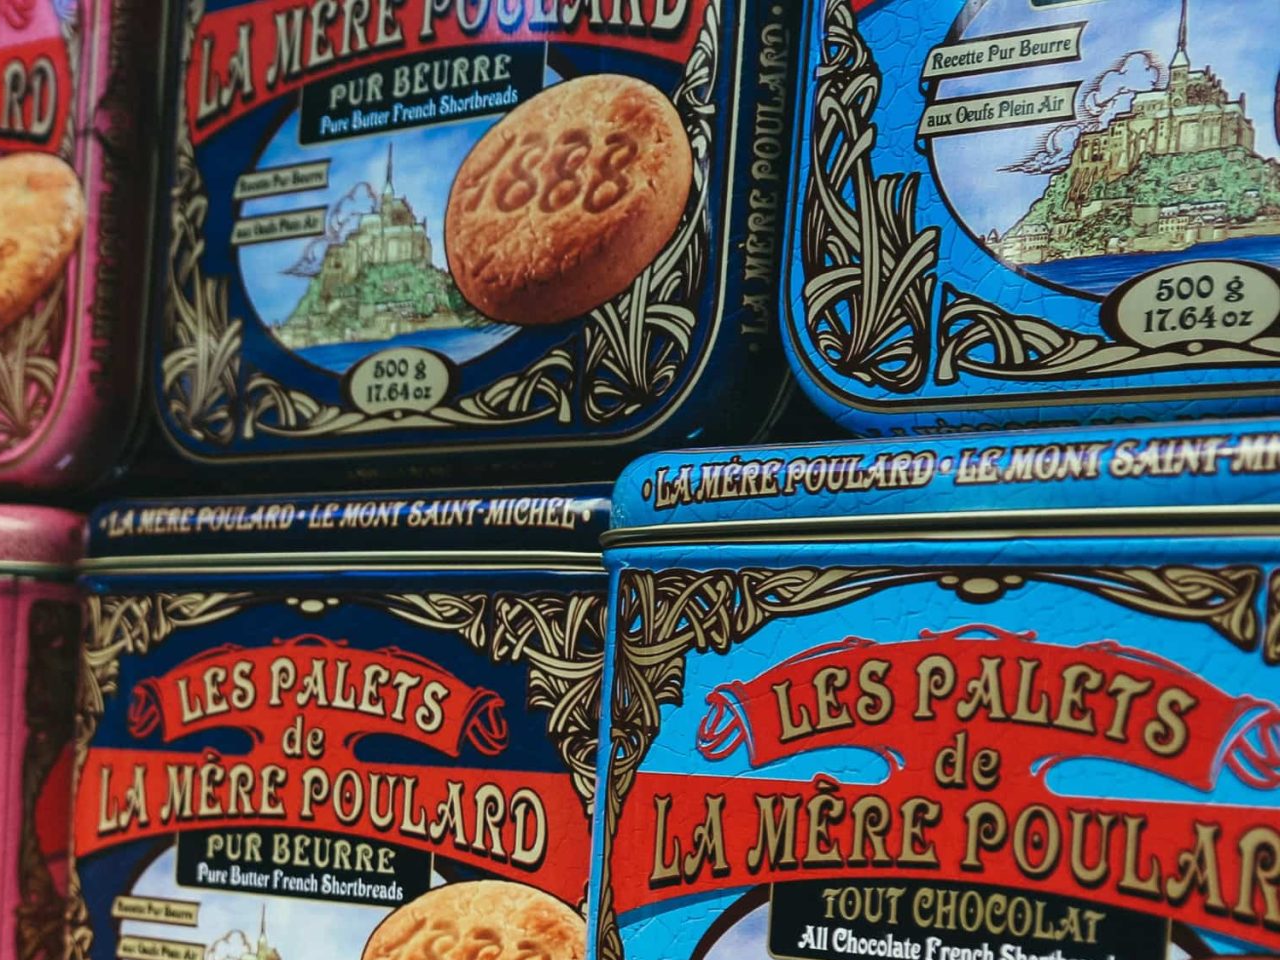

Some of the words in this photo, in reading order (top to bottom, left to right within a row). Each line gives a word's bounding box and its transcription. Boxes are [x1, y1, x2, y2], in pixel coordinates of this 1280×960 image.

[197, 22, 254, 124] LA
[931, 50, 984, 71] Recette
[988, 44, 1016, 62] Pur
[1019, 38, 1072, 58] Beurre
[329, 73, 384, 110] PUR
[392, 54, 512, 98] BEURRE
[751, 23, 789, 181] POULARD
[320, 115, 349, 135] Pure
[351, 108, 389, 129] Butter
[393, 100, 437, 122] French
[439, 85, 519, 116] Shortbreads
[927, 113, 953, 128] aux
[956, 103, 995, 124] Oeufs
[998, 100, 1035, 119] Plein
[1037, 95, 1065, 114] Air
[462, 127, 639, 214] 1888
[738, 188, 777, 282] MÈRE
[1155, 275, 1215, 302] 500
[1224, 275, 1245, 303] g
[741, 293, 769, 336] LA
[1143, 304, 1218, 333] 17.64
[1221, 309, 1255, 328] oz
[367, 382, 411, 404] 17.64
[413, 385, 433, 400] oz
[373, 358, 409, 379] 500
[655, 465, 693, 508] LA
[783, 450, 939, 494] POULARD
[955, 446, 1005, 485] LE
[1004, 440, 1112, 481] MONT
[107, 508, 135, 539] LA
[196, 503, 296, 532] POULARD
[308, 502, 340, 530] LE
[339, 501, 408, 529] MONT
[407, 497, 576, 531] SAINT-MICHEL
[176, 659, 258, 725] LES
[269, 657, 450, 734] PALETS
[770, 659, 896, 744] LES
[912, 652, 1200, 759] PALETS
[281, 713, 326, 759] de
[931, 729, 1003, 789] de
[96, 763, 150, 837] LA
[300, 766, 548, 866] POULARD
[206, 832, 263, 862] PUR
[271, 833, 396, 875] BEURRE
[648, 794, 732, 887] LA
[196, 861, 227, 884] Pure
[229, 865, 270, 889] Butter
[272, 868, 319, 893] French
[320, 873, 404, 901] Shortbreads
[821, 886, 907, 925] TOUT
[912, 887, 1108, 944] CHOCOLAT
[797, 925, 828, 951] All
[831, 927, 922, 960] Chocolate
